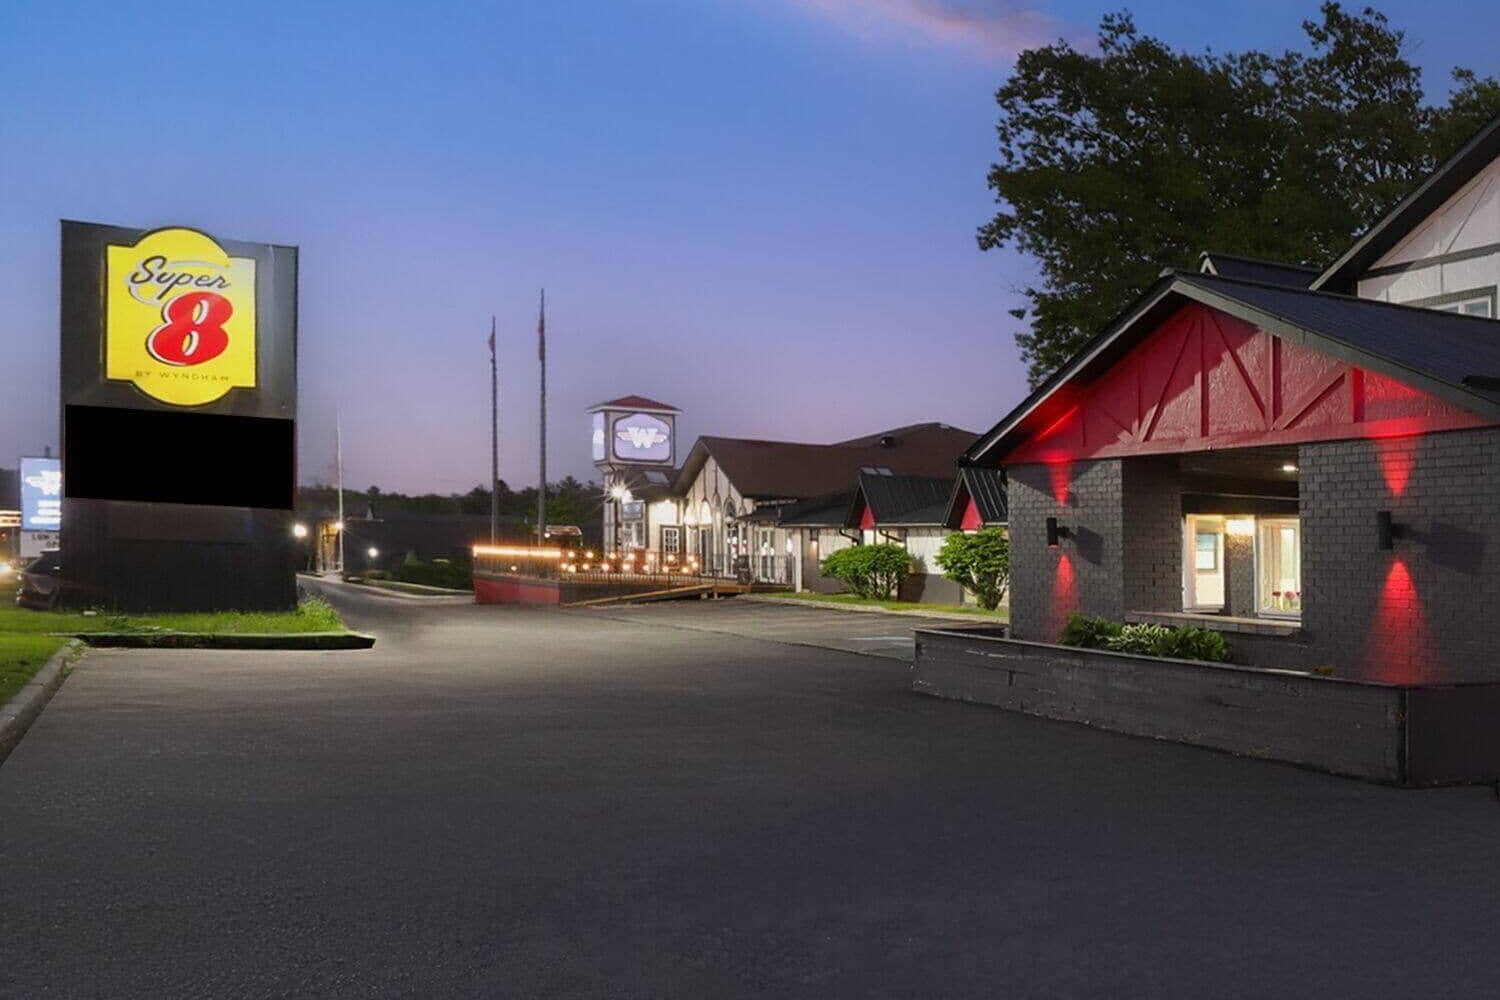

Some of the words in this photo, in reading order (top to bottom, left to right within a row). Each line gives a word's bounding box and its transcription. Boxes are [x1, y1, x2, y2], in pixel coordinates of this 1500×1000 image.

[128, 255, 231, 301] Super
[145, 291, 233, 367] 8
[135, 370, 152, 378] BY
[159, 371, 229, 381] WYNDHAM
